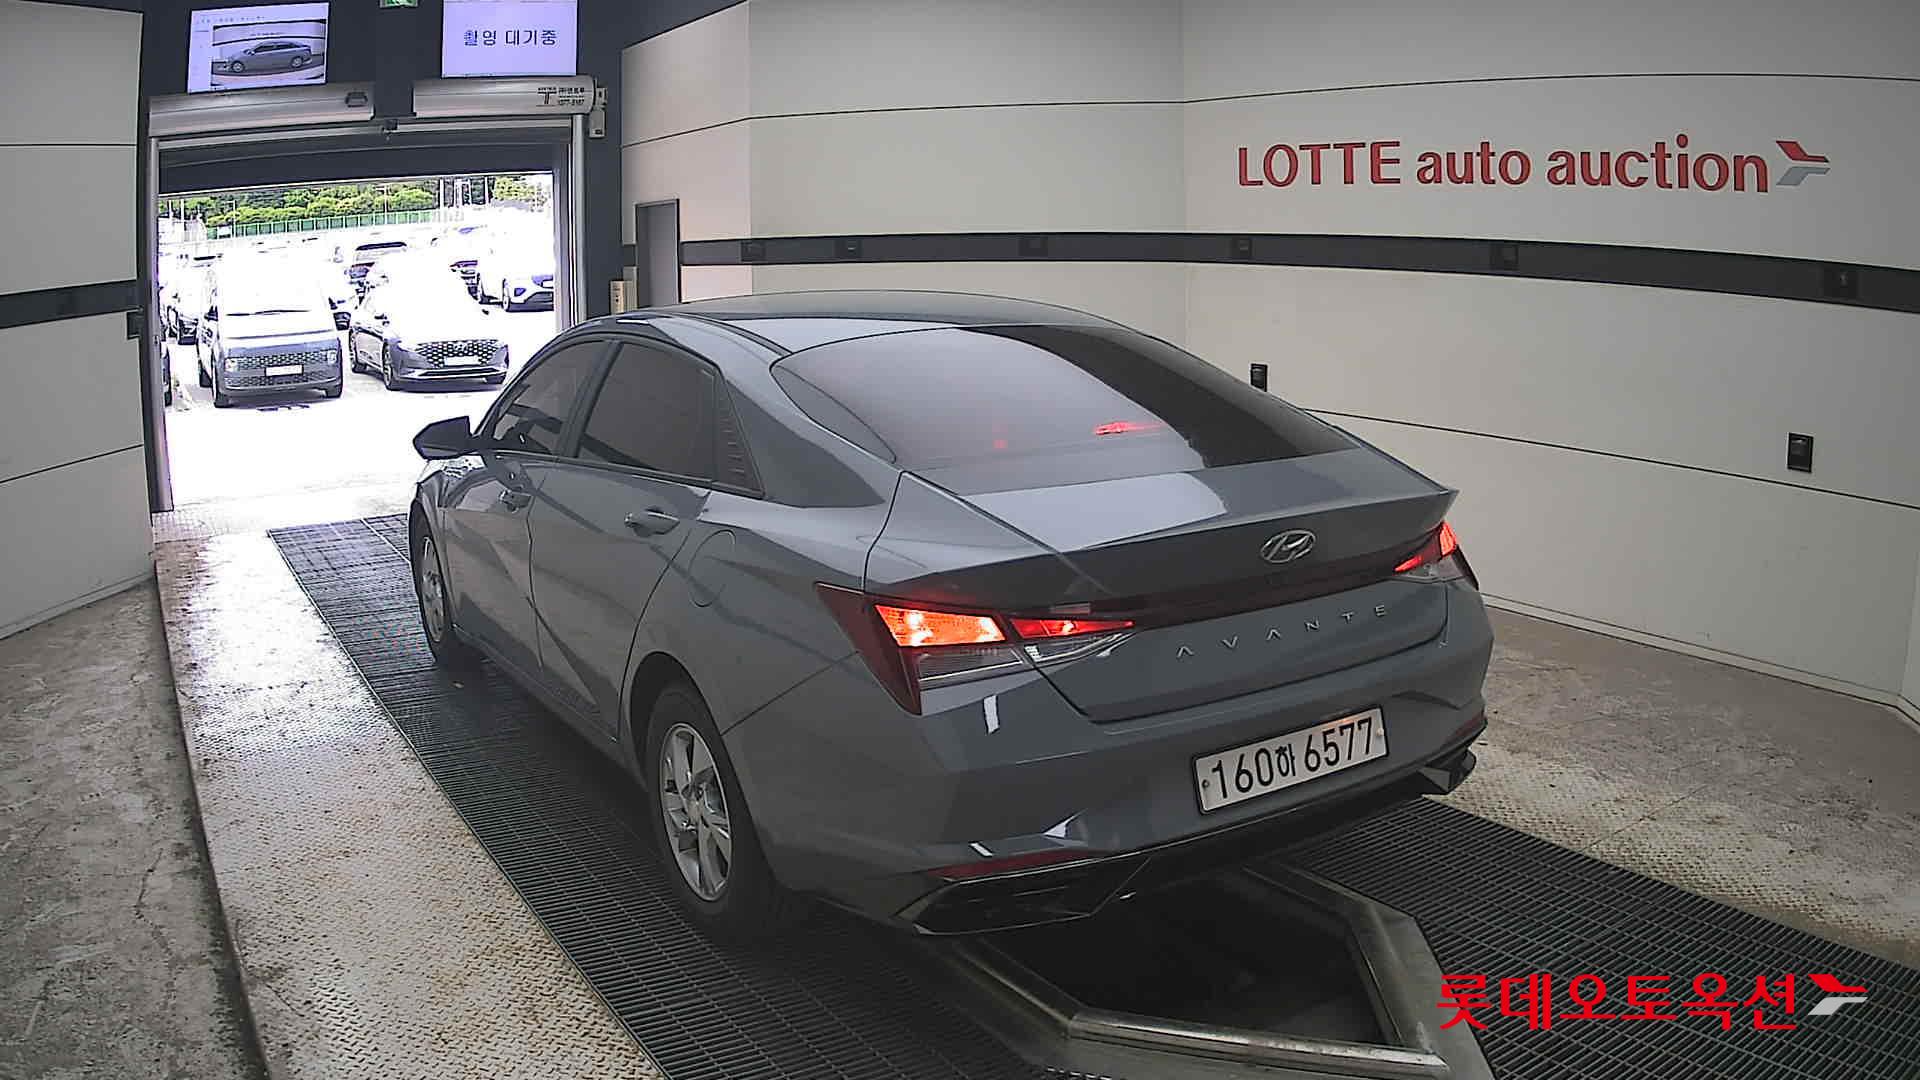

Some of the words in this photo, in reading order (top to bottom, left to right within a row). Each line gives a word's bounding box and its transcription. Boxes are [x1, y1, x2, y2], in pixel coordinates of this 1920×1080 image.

[505, 29, 557, 46] 대기중
[1238, 141, 1401, 187] LOTTE
[1416, 141, 1531, 185] auto
[1547, 133, 1768, 193] auction
[1176, 605, 1387, 659] AVANTE
[1211, 742, 1296, 799] 160하
[1303, 717, 1373, 772] 6577
